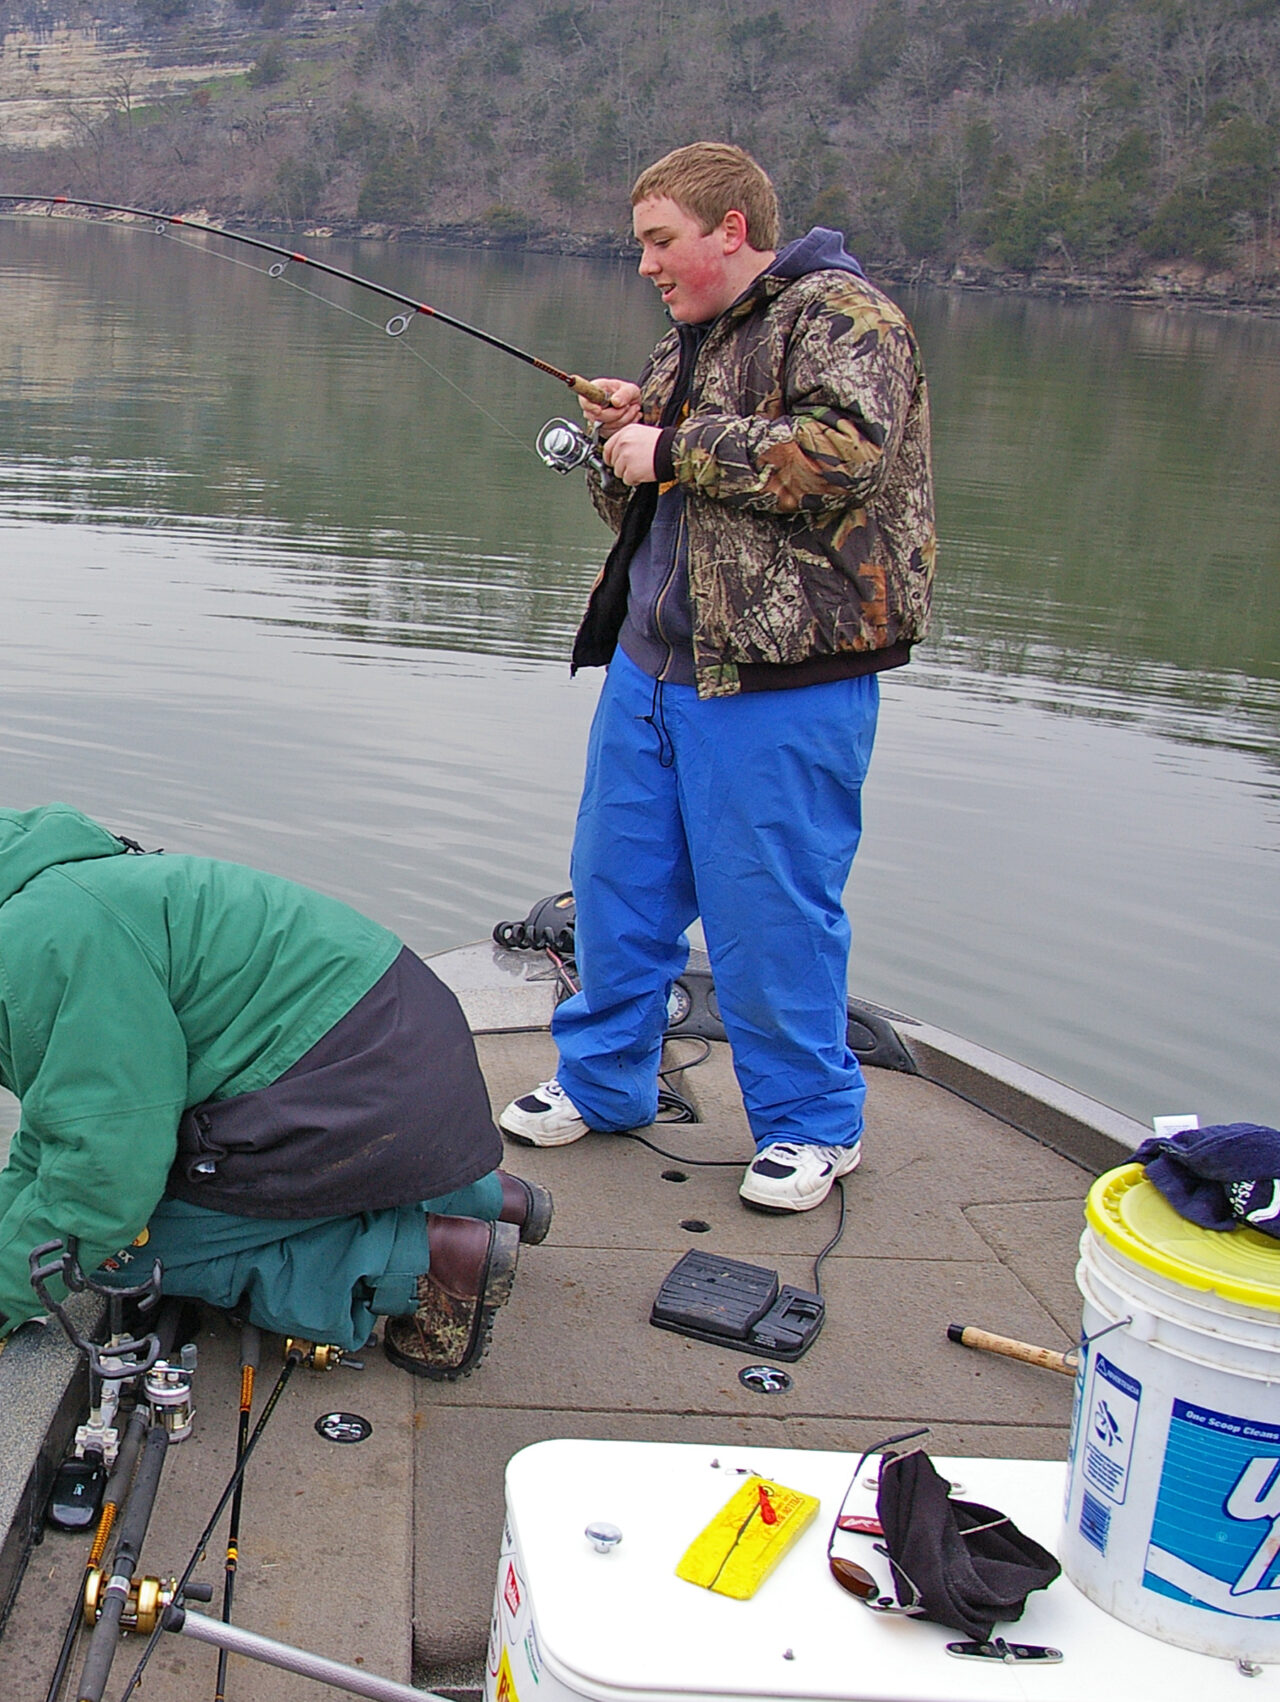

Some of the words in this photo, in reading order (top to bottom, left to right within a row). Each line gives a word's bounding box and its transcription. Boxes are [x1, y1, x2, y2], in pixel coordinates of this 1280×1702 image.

[1185, 1410, 1206, 1423] One
[1207, 1417, 1241, 1433] Scoop
[1243, 1426, 1280, 1440] Cleans
